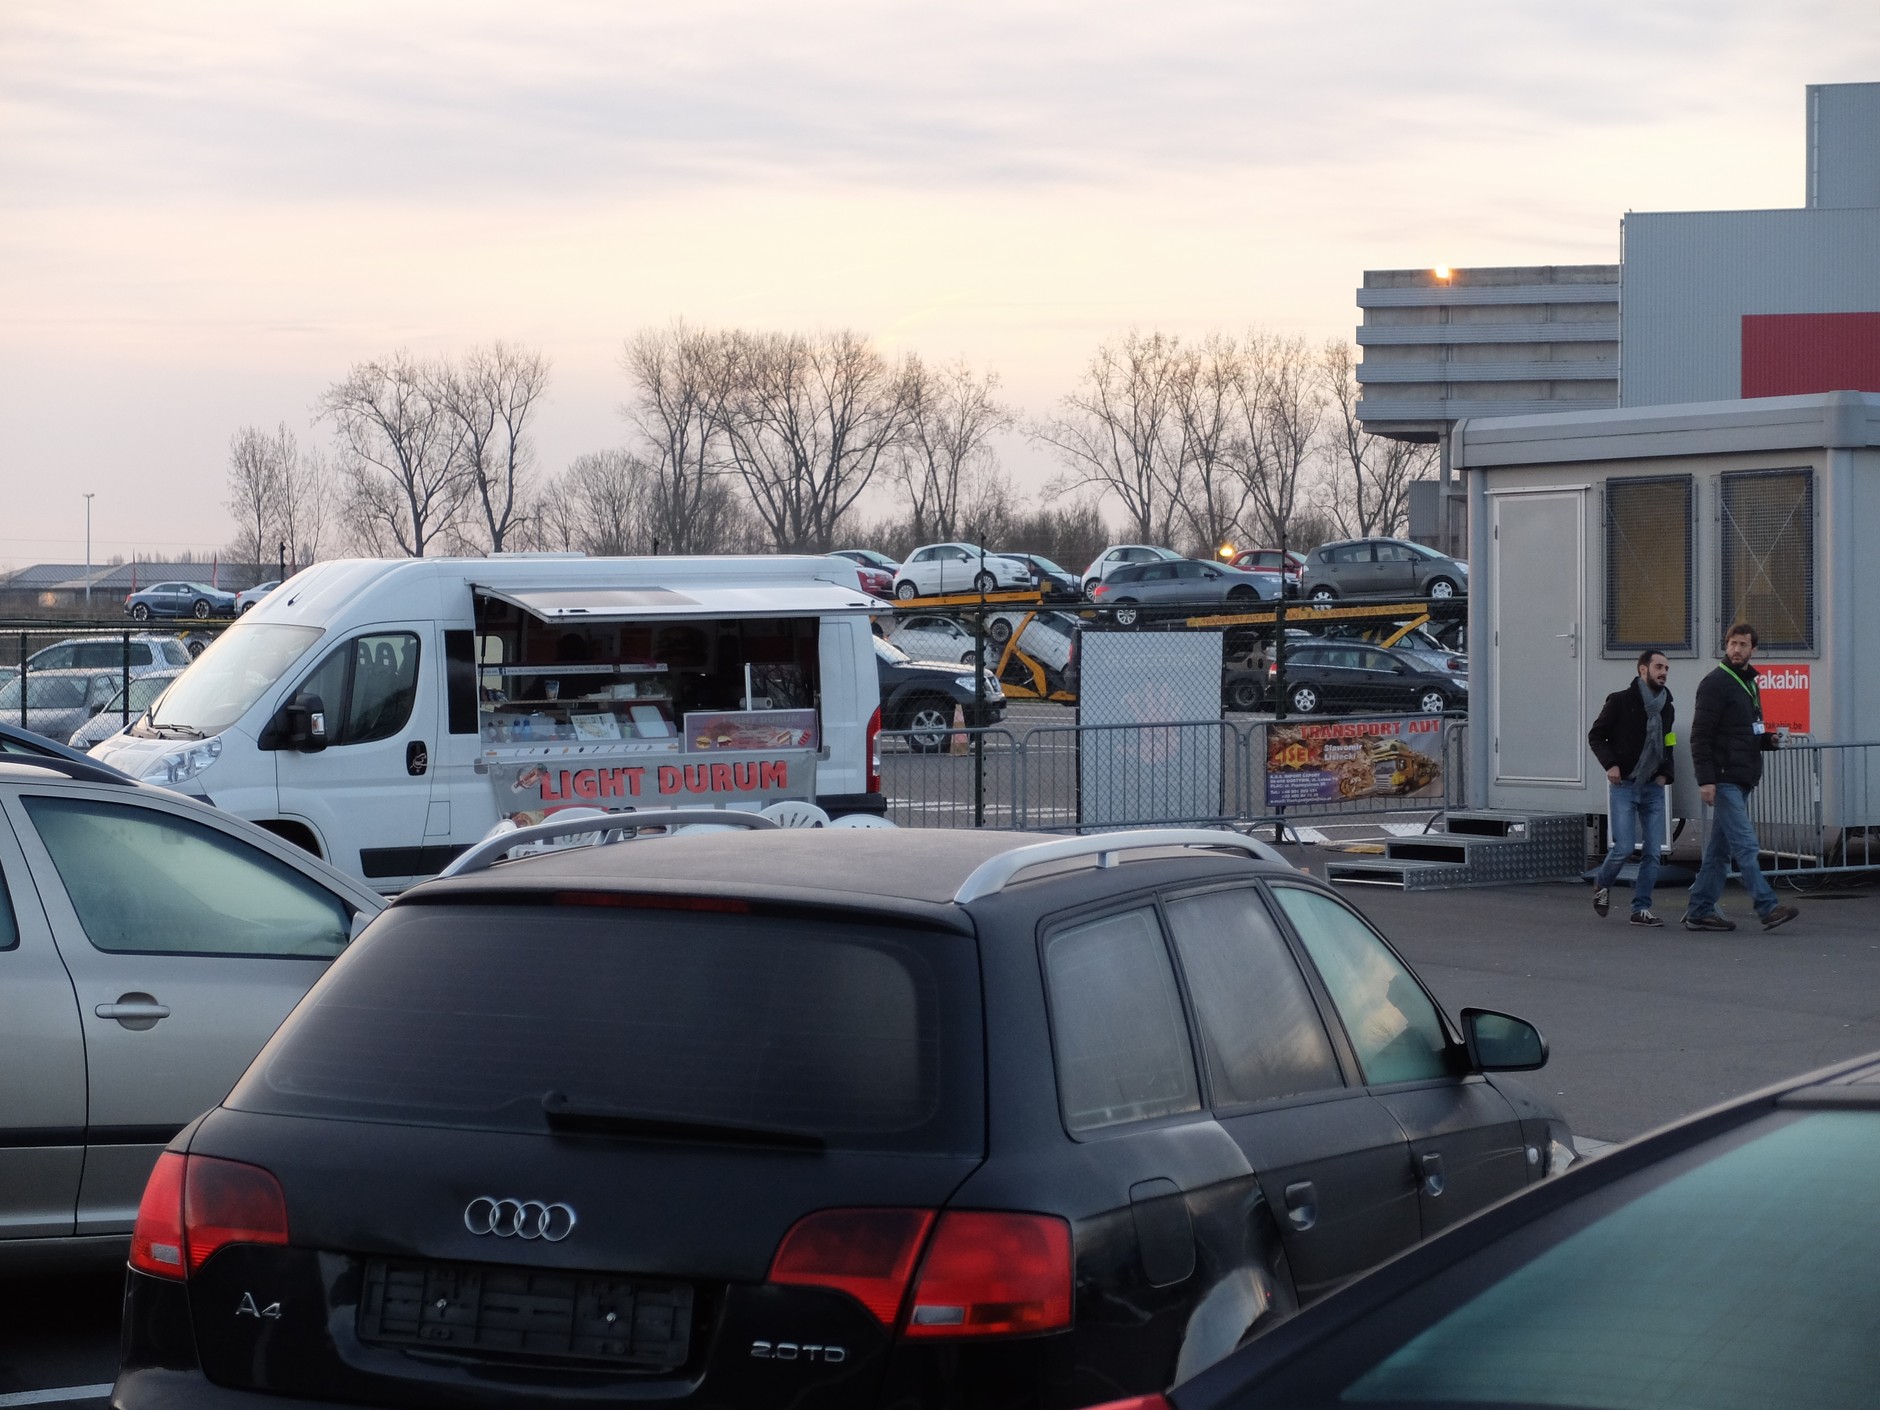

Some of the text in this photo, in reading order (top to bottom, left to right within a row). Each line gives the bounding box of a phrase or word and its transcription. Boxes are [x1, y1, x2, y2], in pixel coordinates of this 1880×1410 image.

[1300, 719, 1441, 740] TRANSPORT AUT
[540, 760, 789, 801] LIGHT DURUM
[235, 1292, 282, 1319] A4
